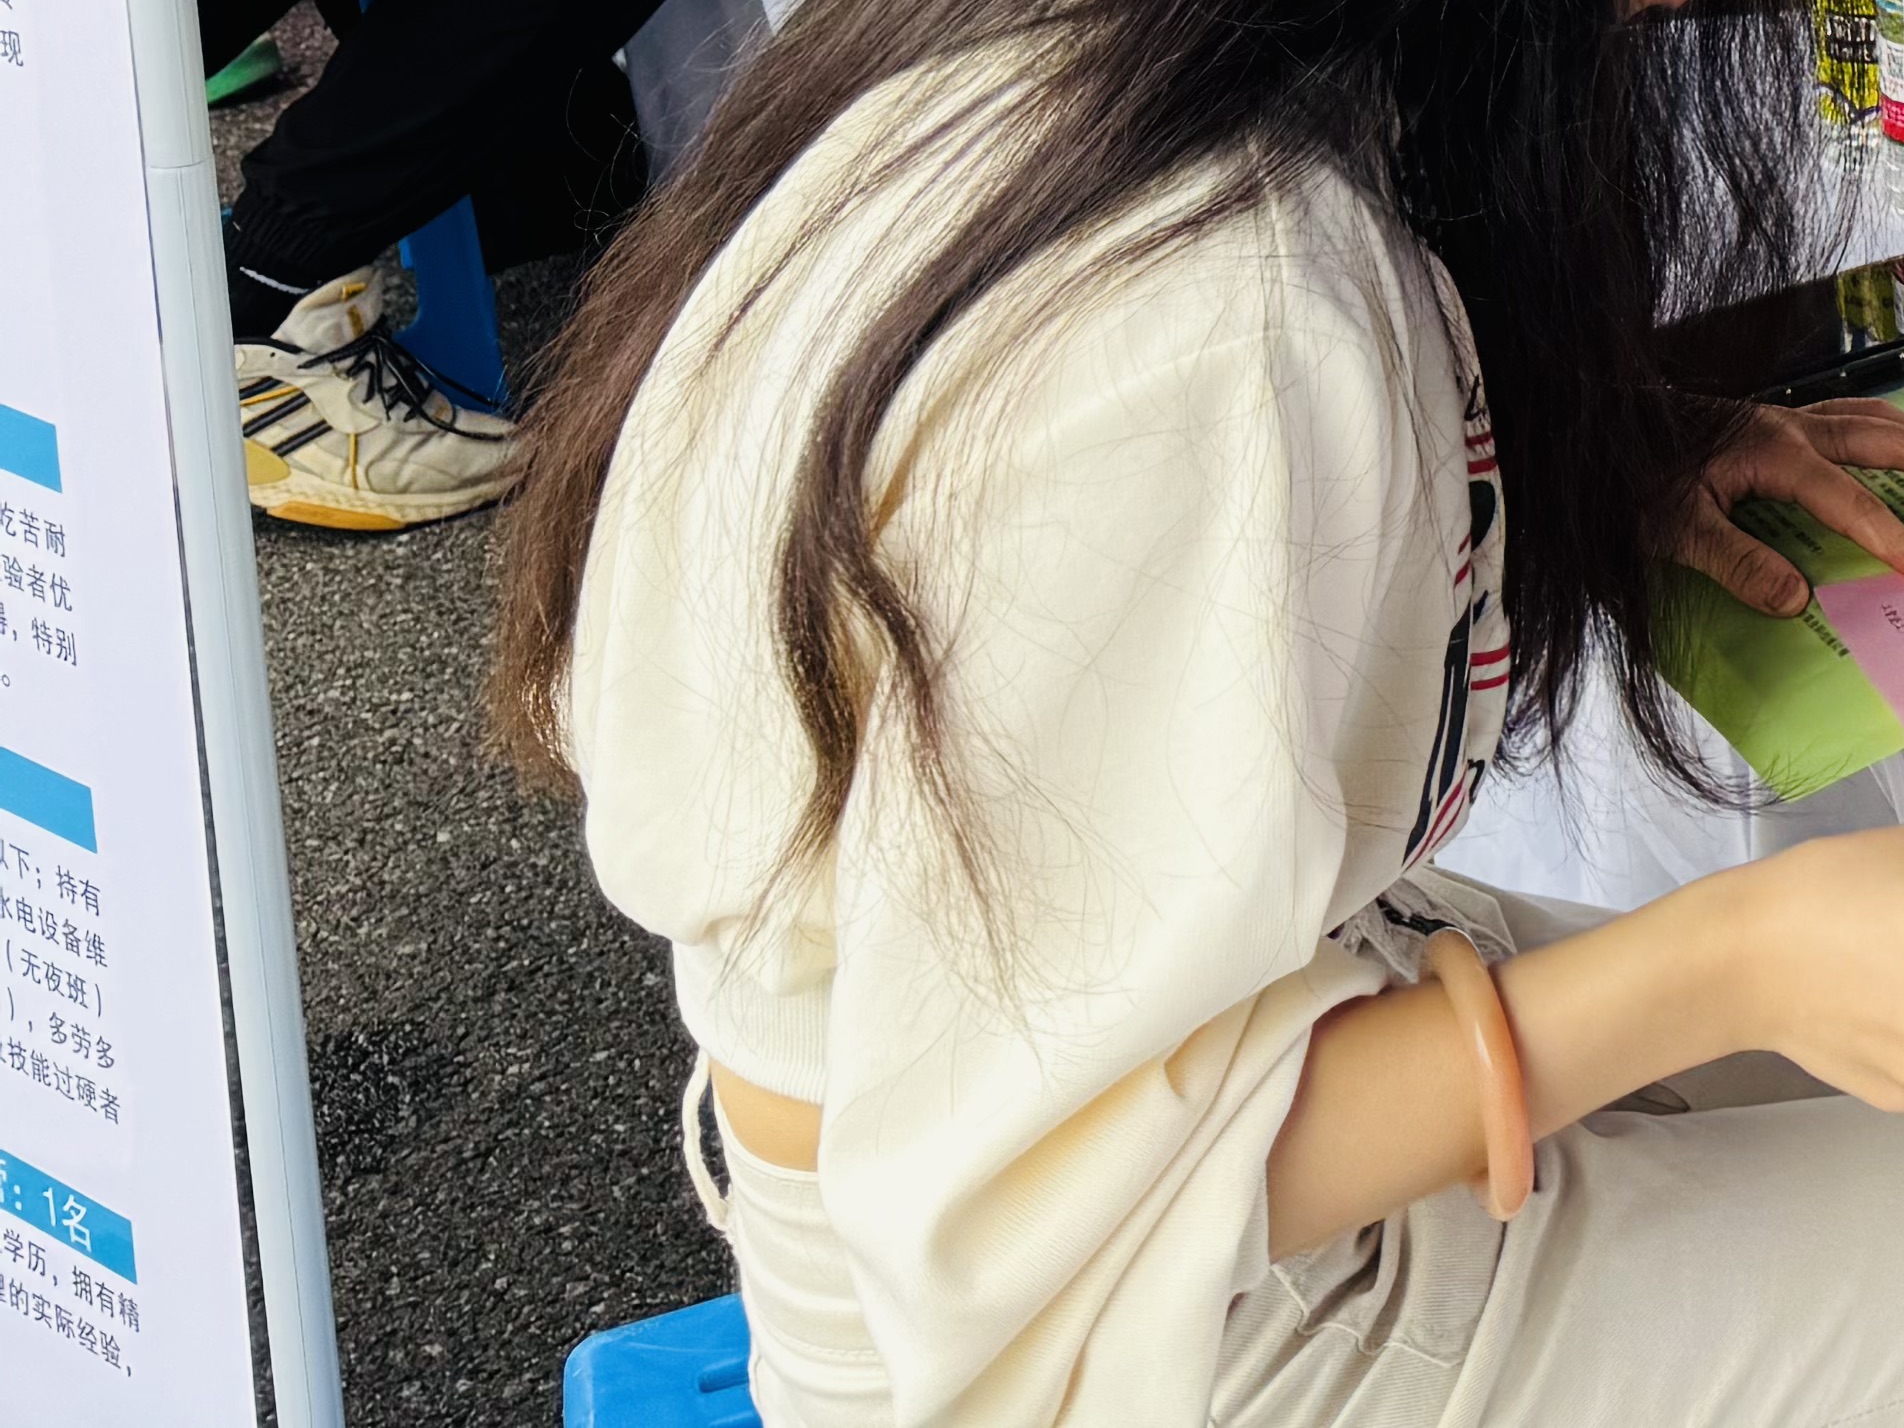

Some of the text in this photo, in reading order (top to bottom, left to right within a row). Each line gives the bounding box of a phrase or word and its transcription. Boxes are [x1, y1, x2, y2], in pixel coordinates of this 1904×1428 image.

[0, 1036, 121, 1125] 技能过硬者
[0, 1273, 133, 1378] 的实际经验，
